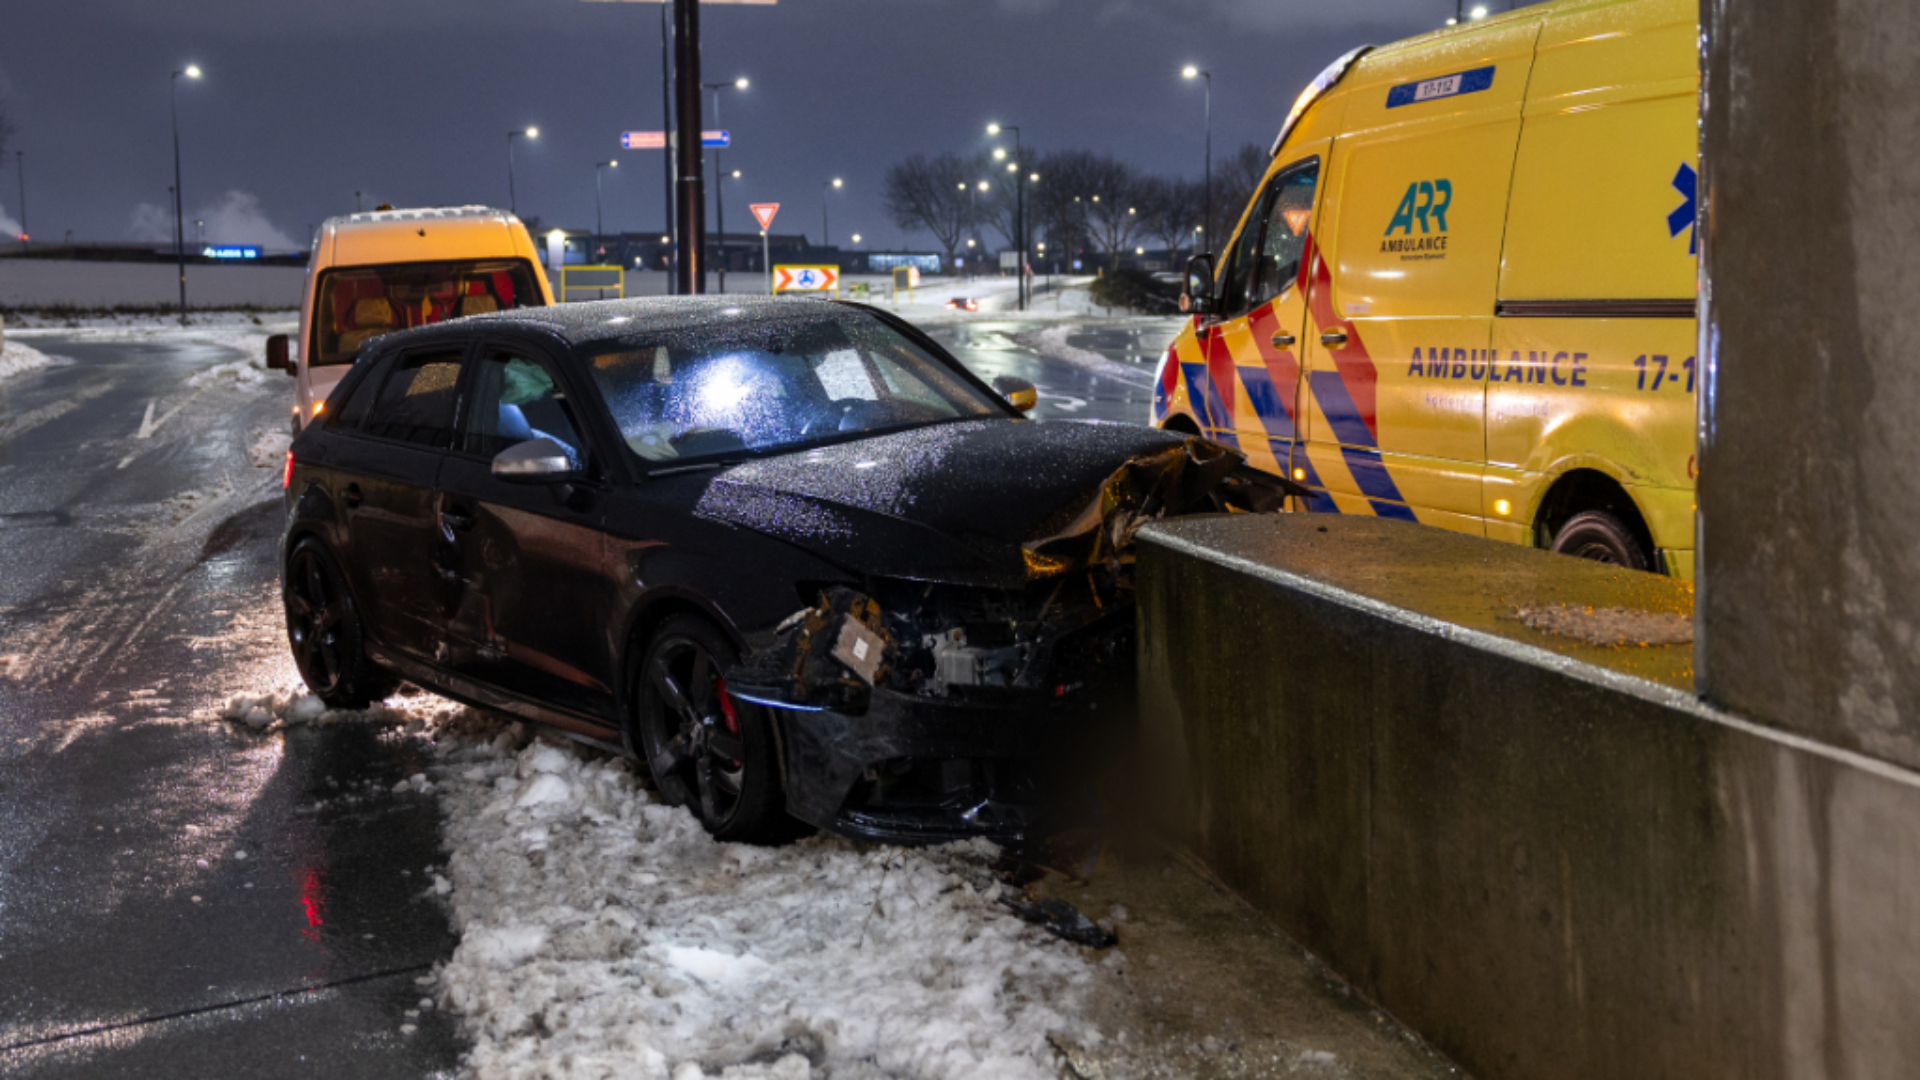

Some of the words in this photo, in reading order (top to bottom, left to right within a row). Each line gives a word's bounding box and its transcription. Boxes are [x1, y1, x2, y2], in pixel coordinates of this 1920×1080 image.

[1423, 79, 1454, 96] 17-112
[1383, 178, 1452, 236] ARR
[1379, 236, 1447, 252] AMBULANCE
[1407, 346, 1588, 387] AMBULANCE
